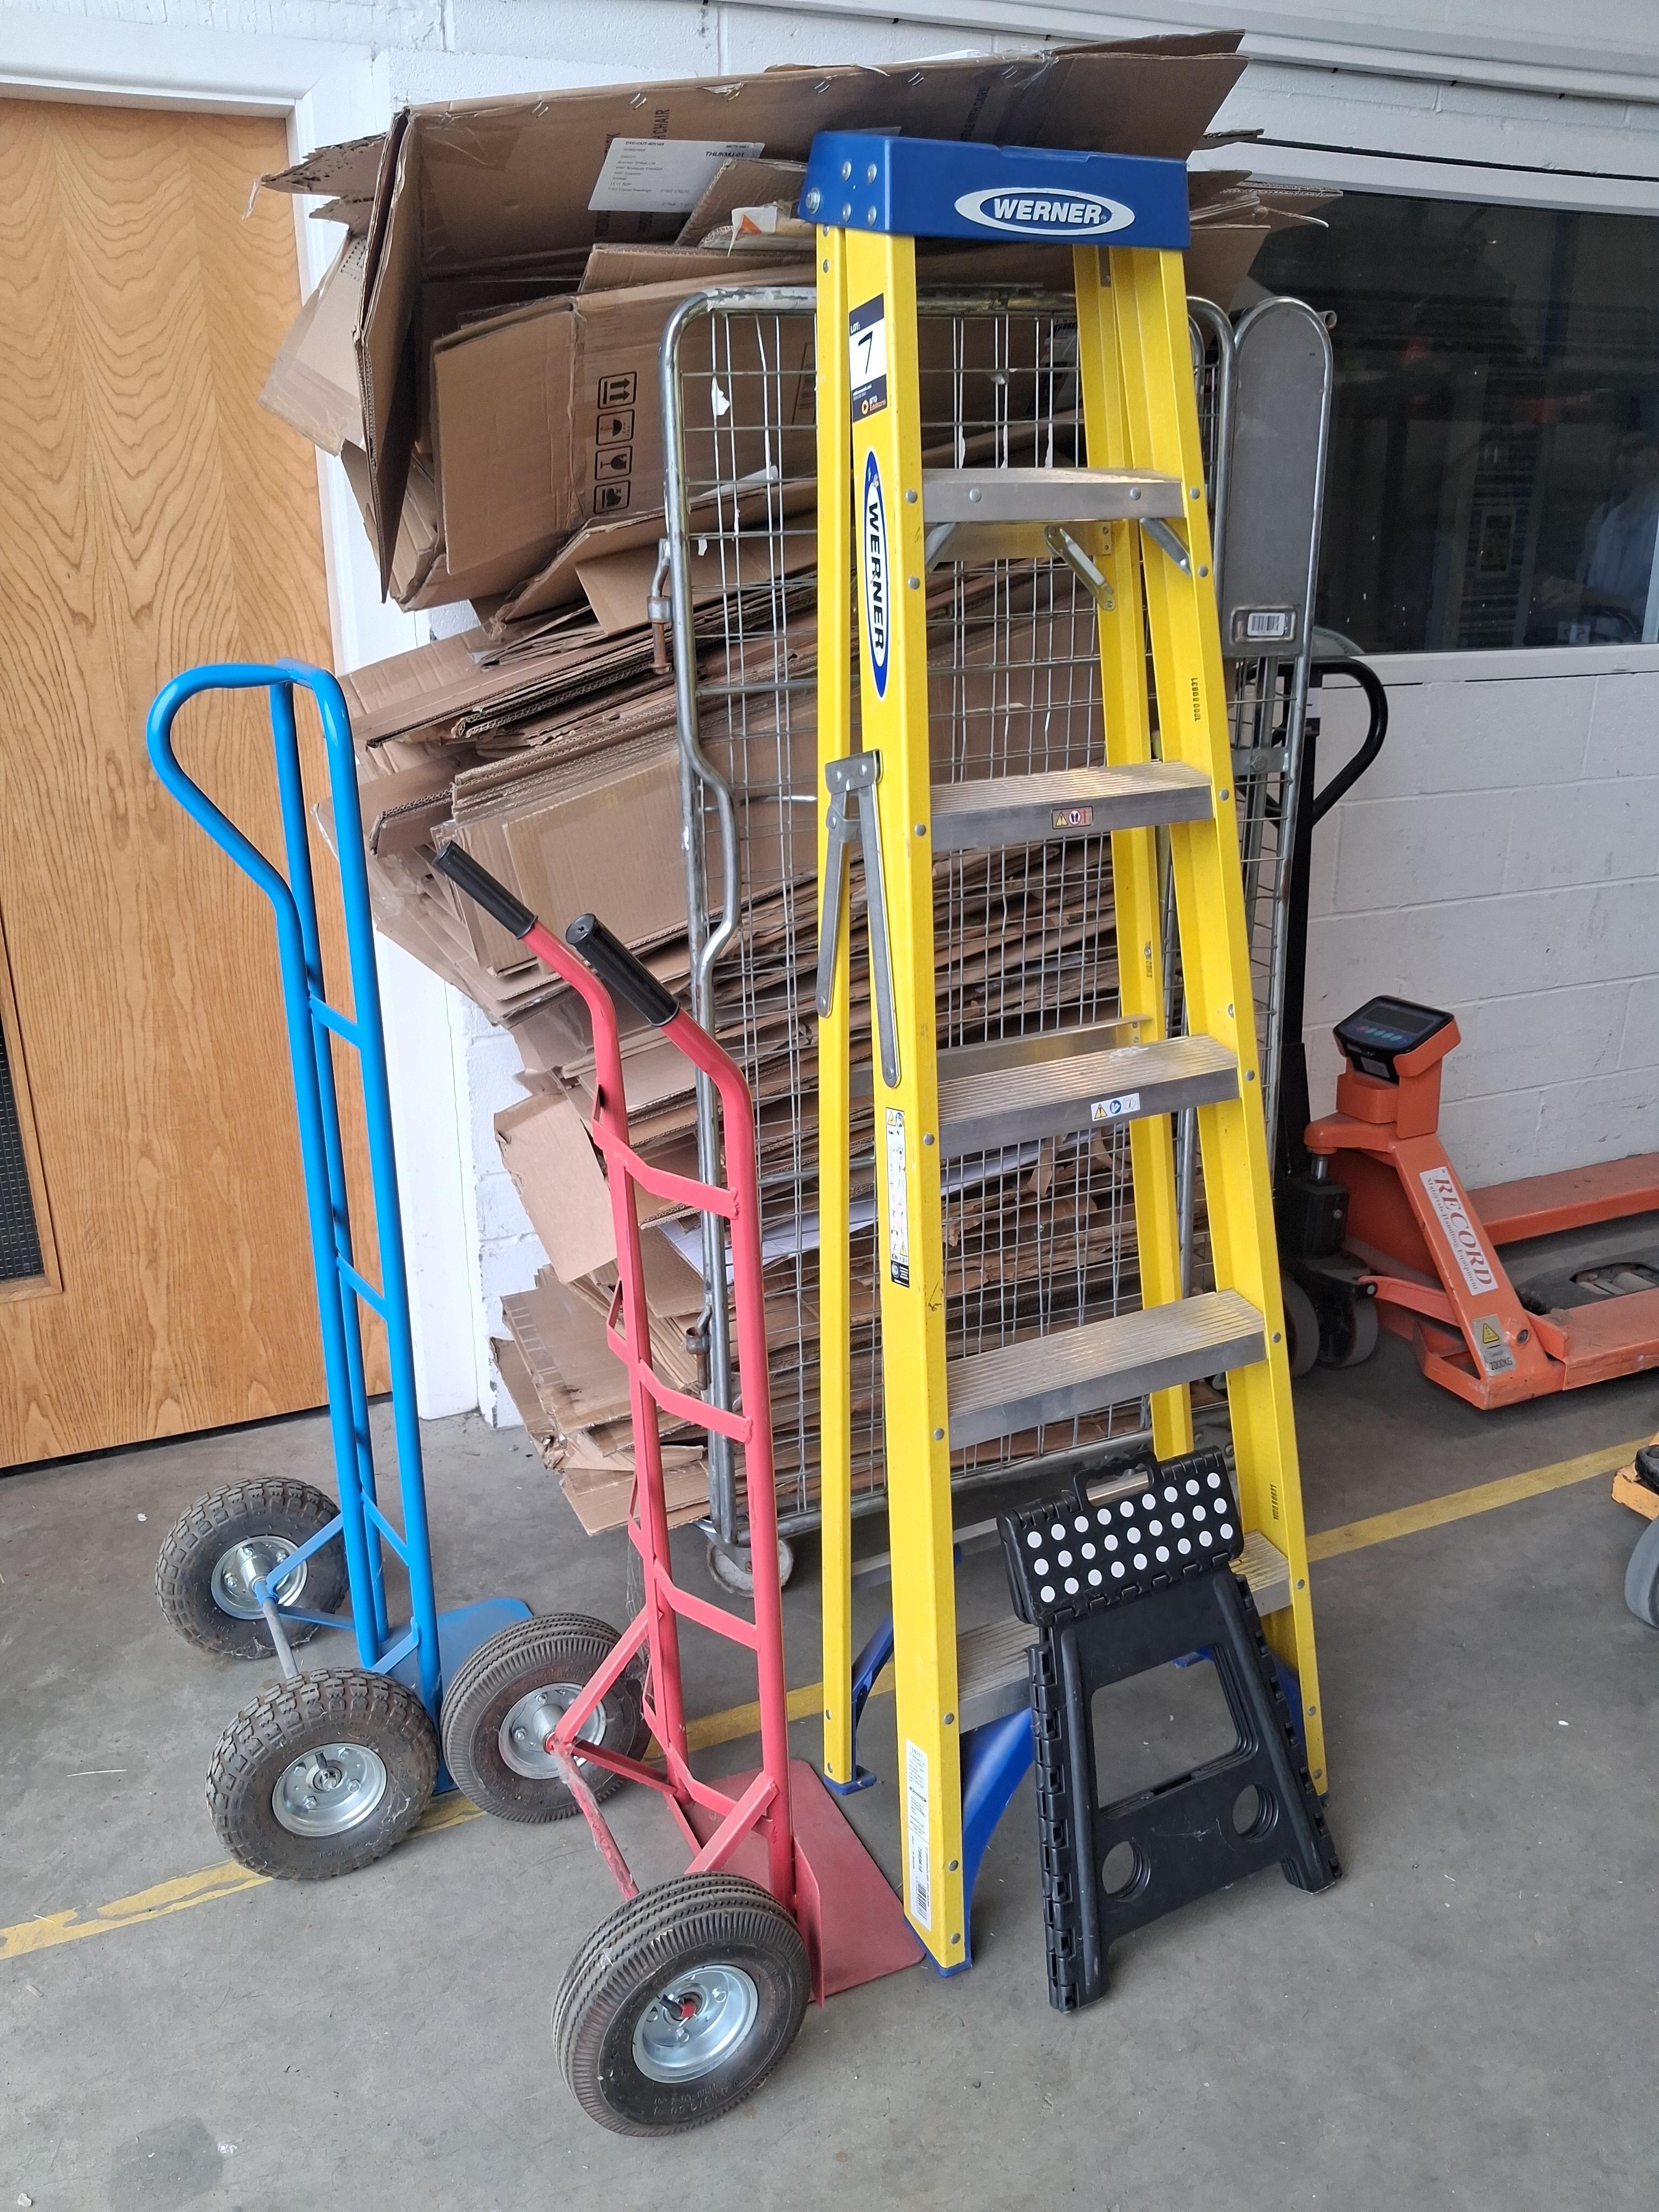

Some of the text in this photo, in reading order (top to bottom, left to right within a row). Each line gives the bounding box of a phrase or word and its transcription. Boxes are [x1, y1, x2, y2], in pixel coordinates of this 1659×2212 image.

[653, 109, 670, 134] CHAIR
[993, 197, 1102, 225] WERNER
[858, 330, 873, 375] 7
[869, 502, 884, 650] WERNER
[1427, 1178, 1479, 1290] Materials Handling Equipment
[1433, 1178, 1492, 1285] RECORD
